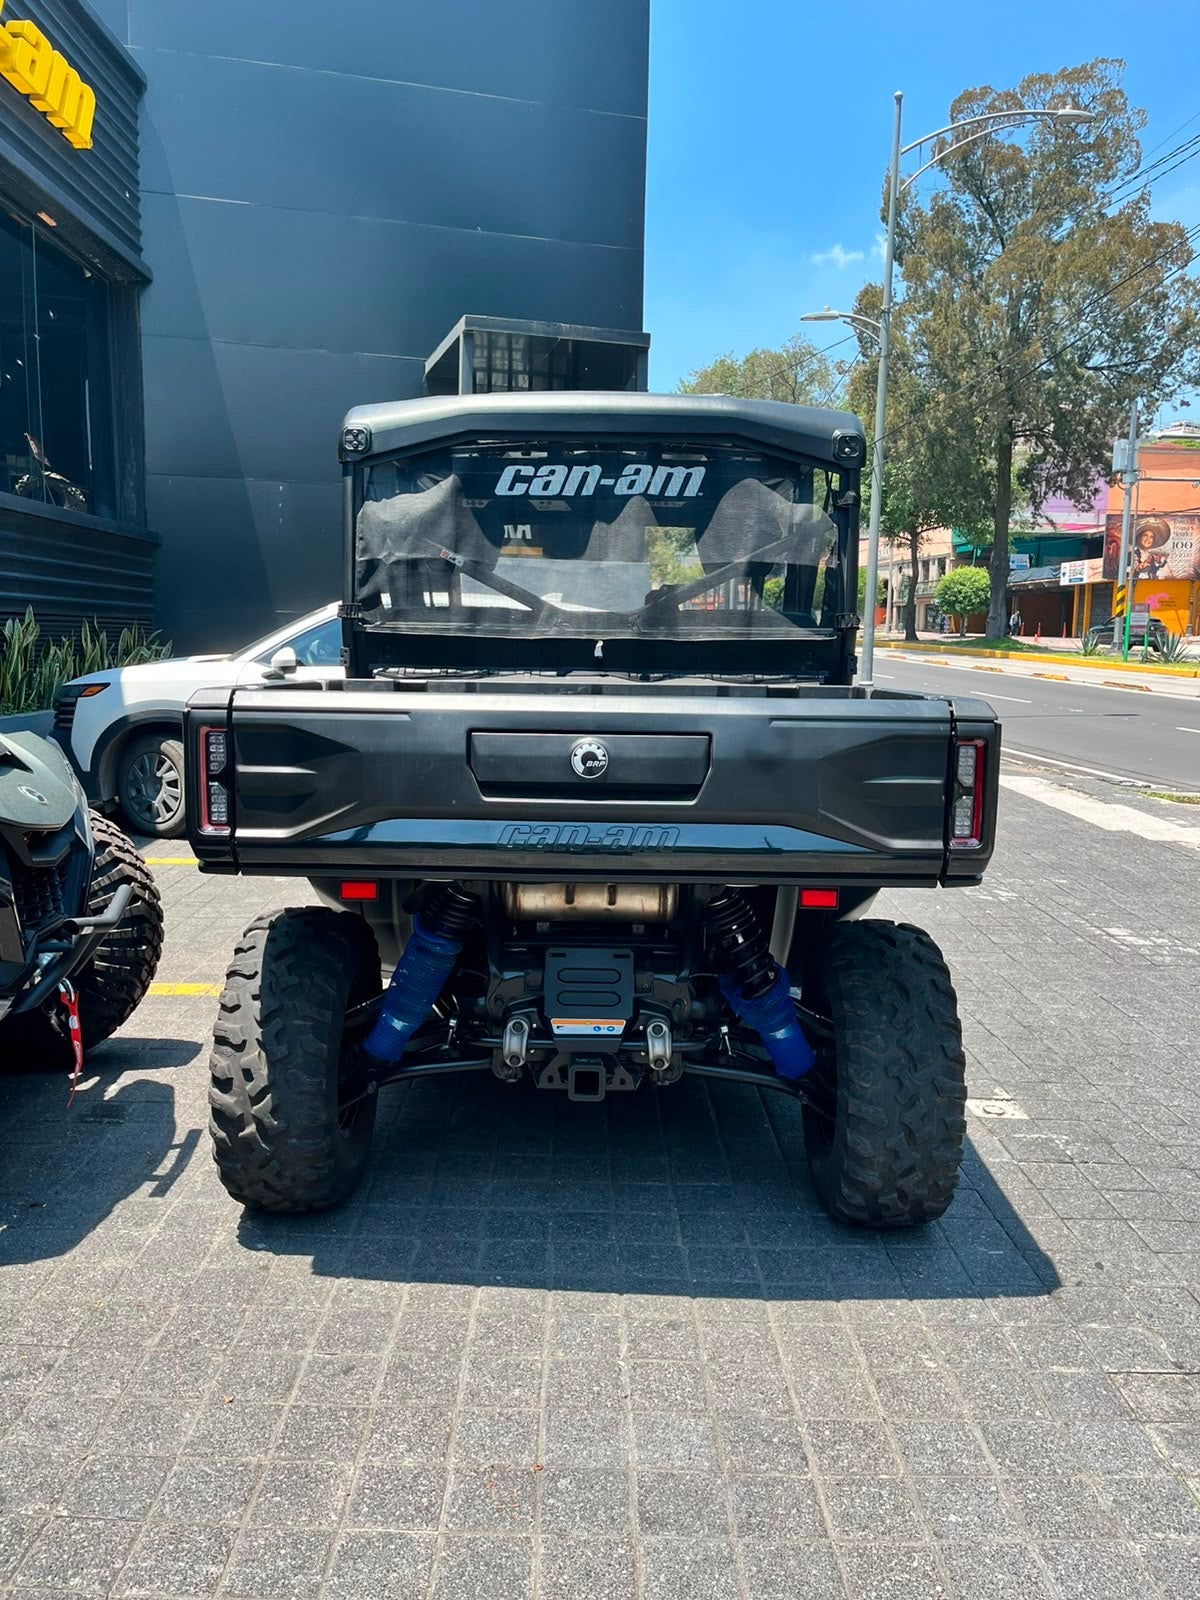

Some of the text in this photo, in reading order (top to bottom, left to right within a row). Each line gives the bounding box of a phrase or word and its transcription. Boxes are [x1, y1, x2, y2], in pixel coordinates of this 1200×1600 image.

[495, 464, 706, 497] can-am
[1172, 541, 1193, 549] 100
[498, 824, 681, 852] can-am
